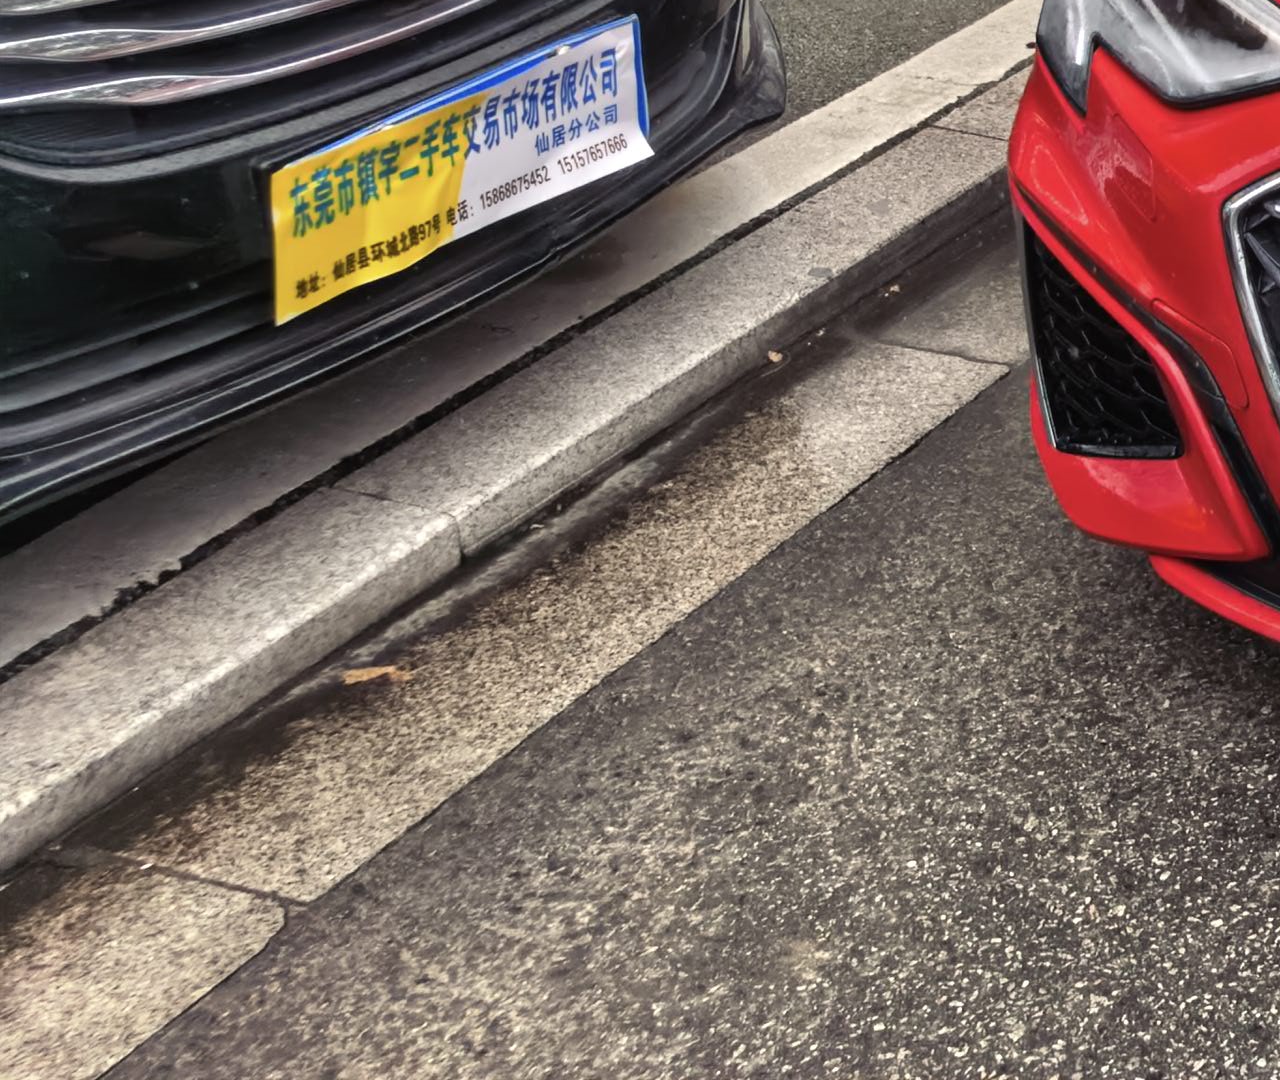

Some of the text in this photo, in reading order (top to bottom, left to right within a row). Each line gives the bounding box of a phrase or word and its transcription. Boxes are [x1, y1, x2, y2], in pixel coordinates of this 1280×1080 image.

[534, 103, 619, 157] 仙居分公司
[557, 132, 628, 175] 15157657666
